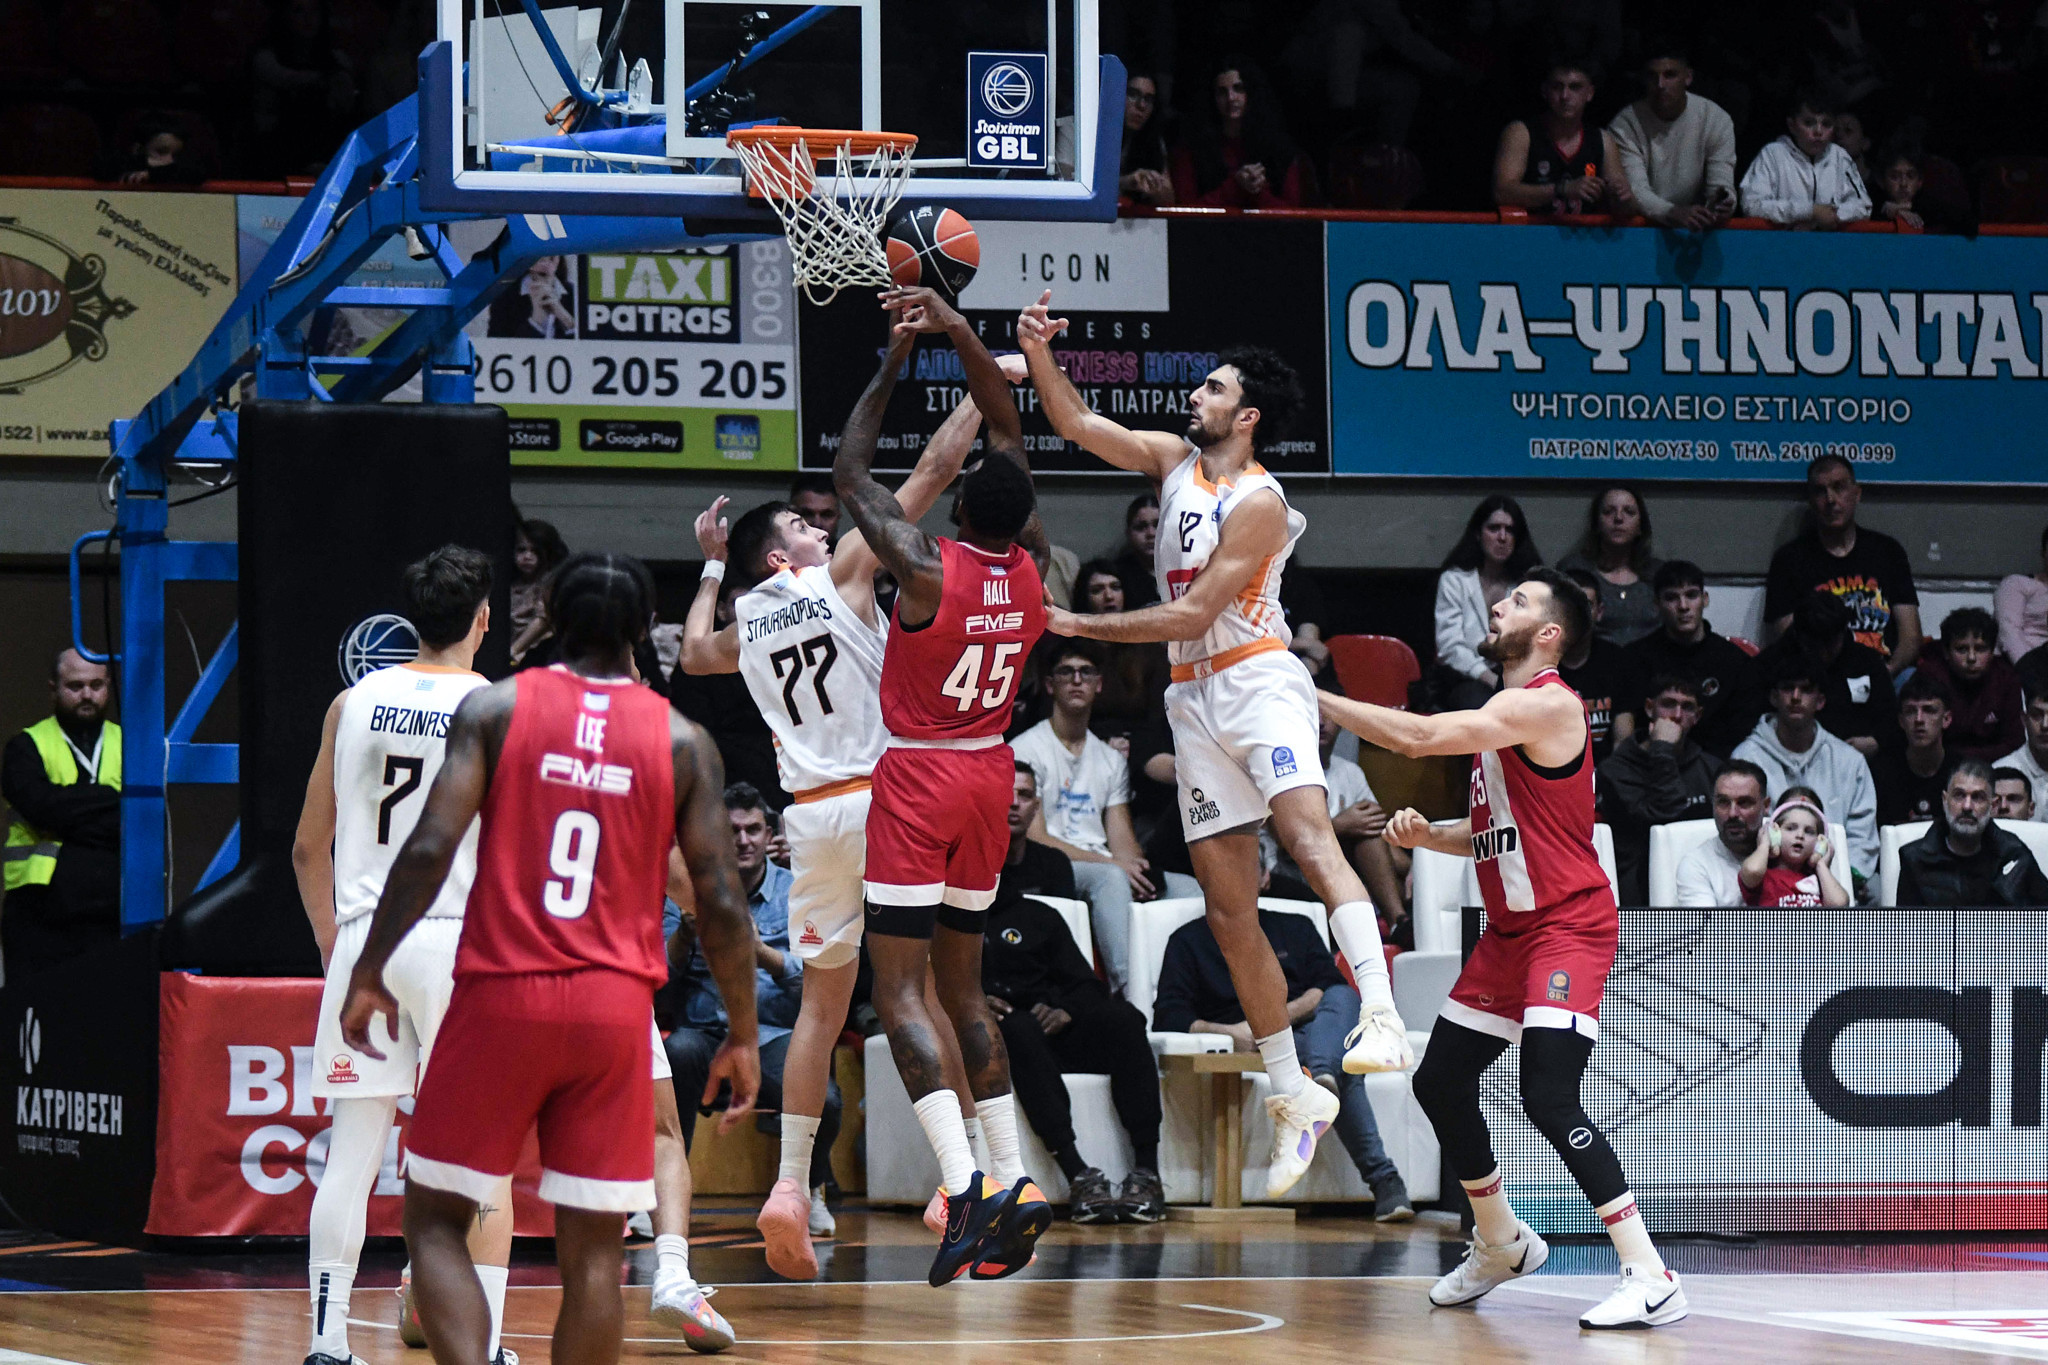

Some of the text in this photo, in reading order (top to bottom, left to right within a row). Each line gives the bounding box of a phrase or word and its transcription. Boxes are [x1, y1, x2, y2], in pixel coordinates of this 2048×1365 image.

[975, 119, 1040, 135] Stoiximan
[977, 135, 1037, 160] GBL
[590, 256, 727, 302] TAXI
[977, 319, 1151, 339] FINESS
[1346, 280, 2048, 378] ΟΛΑ-ΨΗΝΟΝΤΑ
[591, 356, 680, 397] 205
[699, 358, 787, 400] 205
[1111, 389, 1190, 414] ΠΑΤΡΑΣ
[1511, 391, 1913, 424] ΨΗΤΟΠΩΛΕΙΟ ΕΣΤΙΑΤΟΡΙΟ
[0, 426, 33, 440] 522
[516, 432, 551, 445] Store
[605, 432, 679, 449] Google Play
[1530, 438, 1609, 459] ΠΑΤΡΩΝ
[1695, 442, 1719, 461] 30
[1731, 440, 1776, 462] ΤΗΛ.
[1178, 510, 1203, 553] 12
[983, 579, 1012, 606] HALL
[966, 611, 1024, 634] FMS
[769, 632, 838, 727] 77
[941, 641, 1023, 712] 45
[369, 704, 453, 739] BAZINAS
[575, 712, 608, 754] LEE
[541, 752, 634, 795] FMS
[377, 753, 425, 846] 7
[1189, 800, 1218, 816] SUPER
[1190, 808, 1221, 825] CARGO
[543, 808, 601, 920] 9
[17, 1085, 123, 1136] ΚΑΤΡΙΒΕΣΗ
